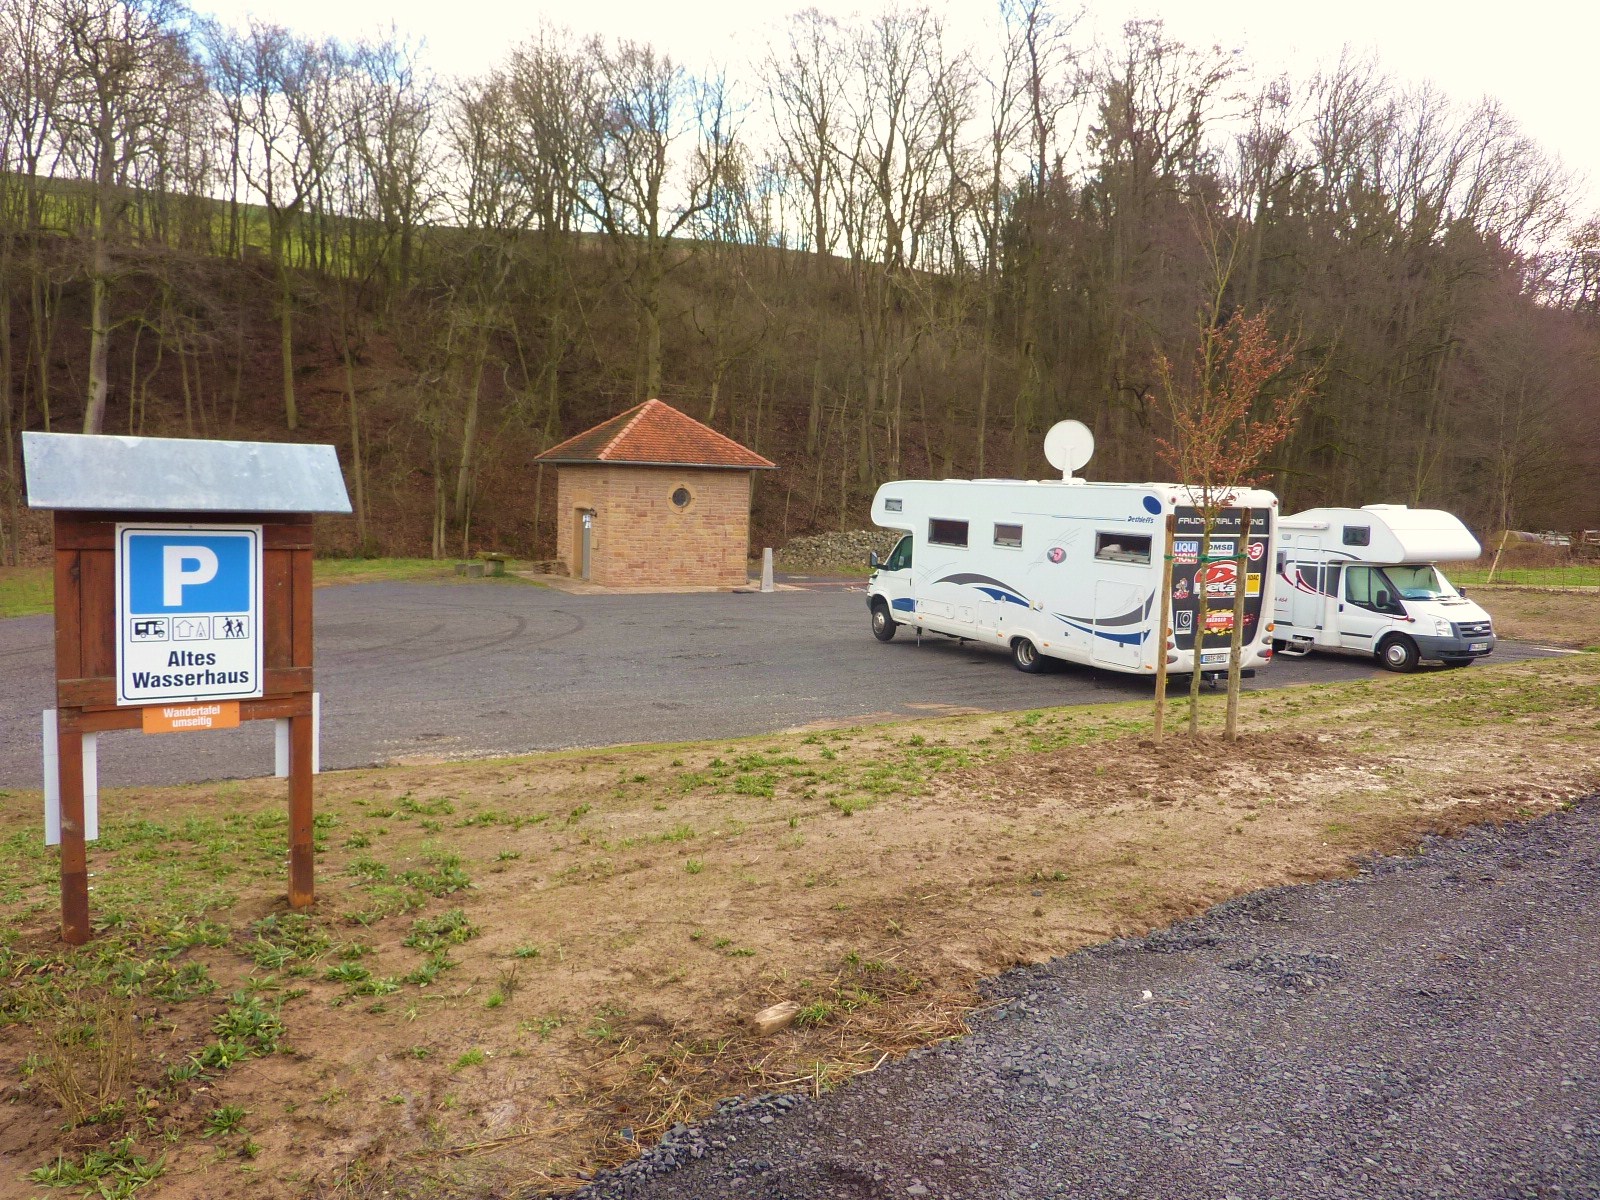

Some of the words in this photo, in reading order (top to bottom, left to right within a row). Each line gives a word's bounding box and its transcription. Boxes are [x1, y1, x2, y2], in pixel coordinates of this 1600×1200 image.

[1175, 542, 1196, 552] LIQUI
[163, 545, 219, 607] P
[167, 650, 216, 667] Altes
[132, 669, 249, 689] Wasserhaus
[163, 705, 221, 718] Wandertafel
[172, 716, 212, 728] umseitig
